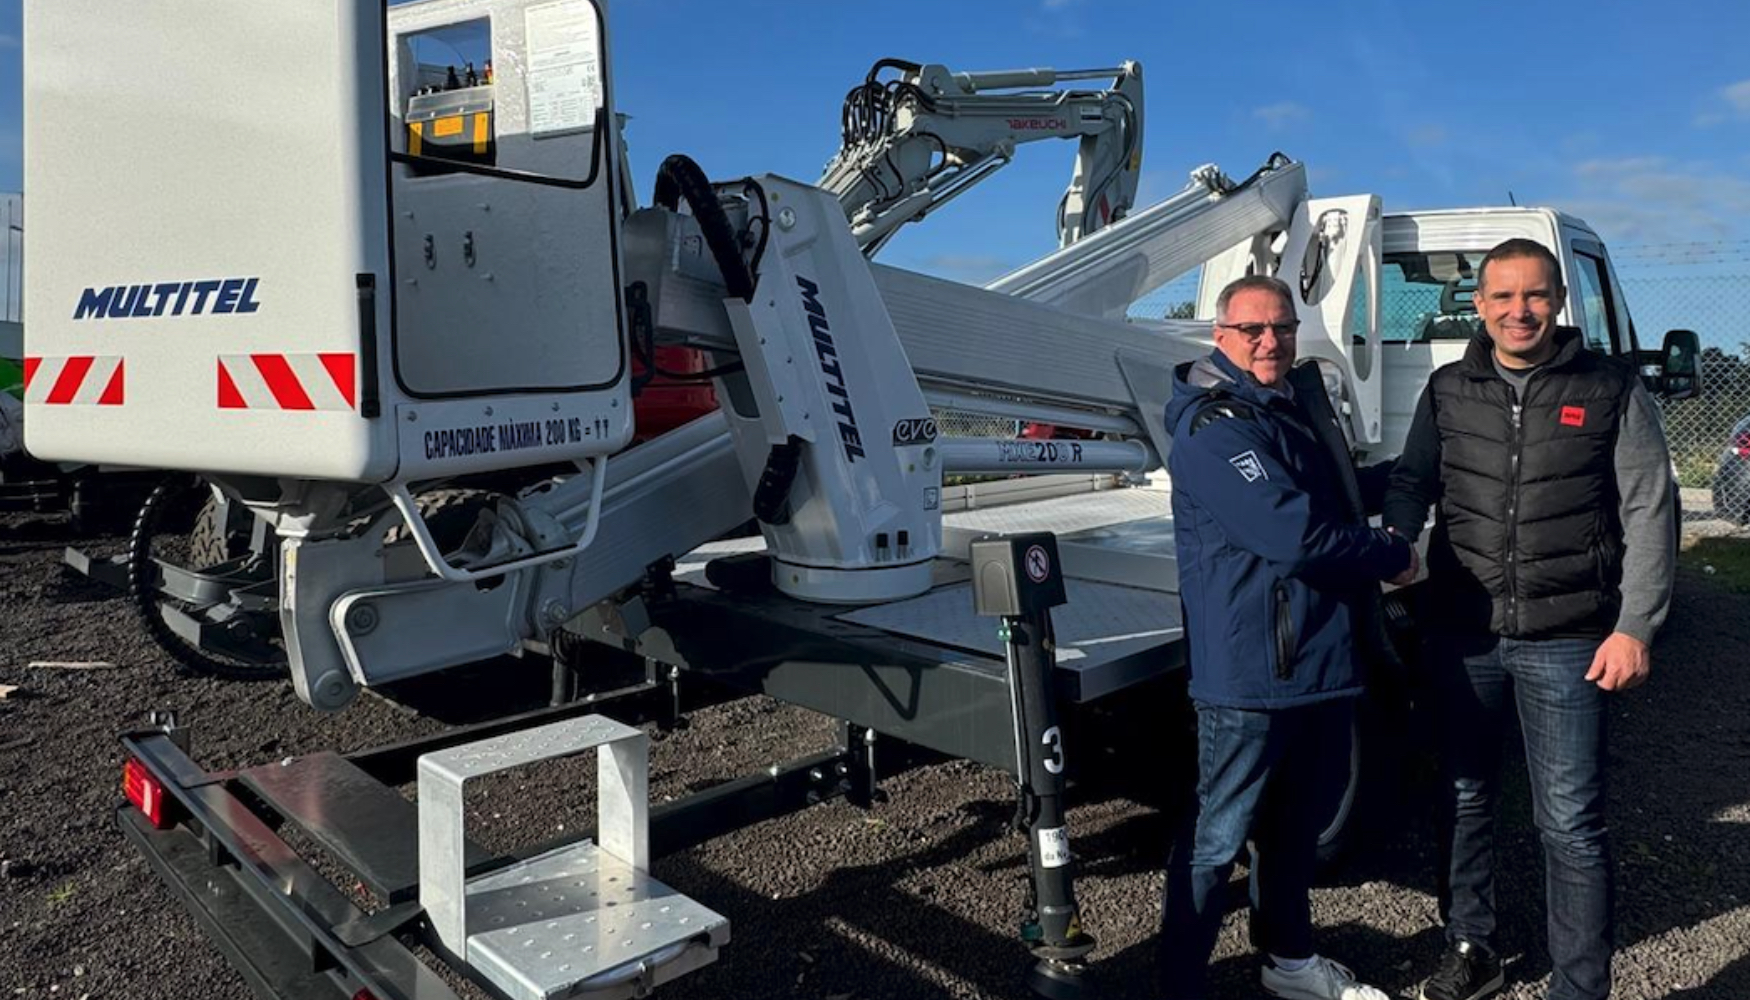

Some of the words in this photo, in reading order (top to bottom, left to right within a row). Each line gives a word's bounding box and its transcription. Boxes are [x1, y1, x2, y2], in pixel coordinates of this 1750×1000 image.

[1007, 118, 1067, 130] TAKEUCHI
[73, 277, 260, 320] MULTITEL
[795, 274, 865, 464] MULTITEL
[424, 425, 496, 460] CAPACIDADE
[546, 419, 566, 446] 200
[568, 417, 582, 443] KG
[1071, 442, 1083, 462] R
[1041, 725, 1064, 775] 3
